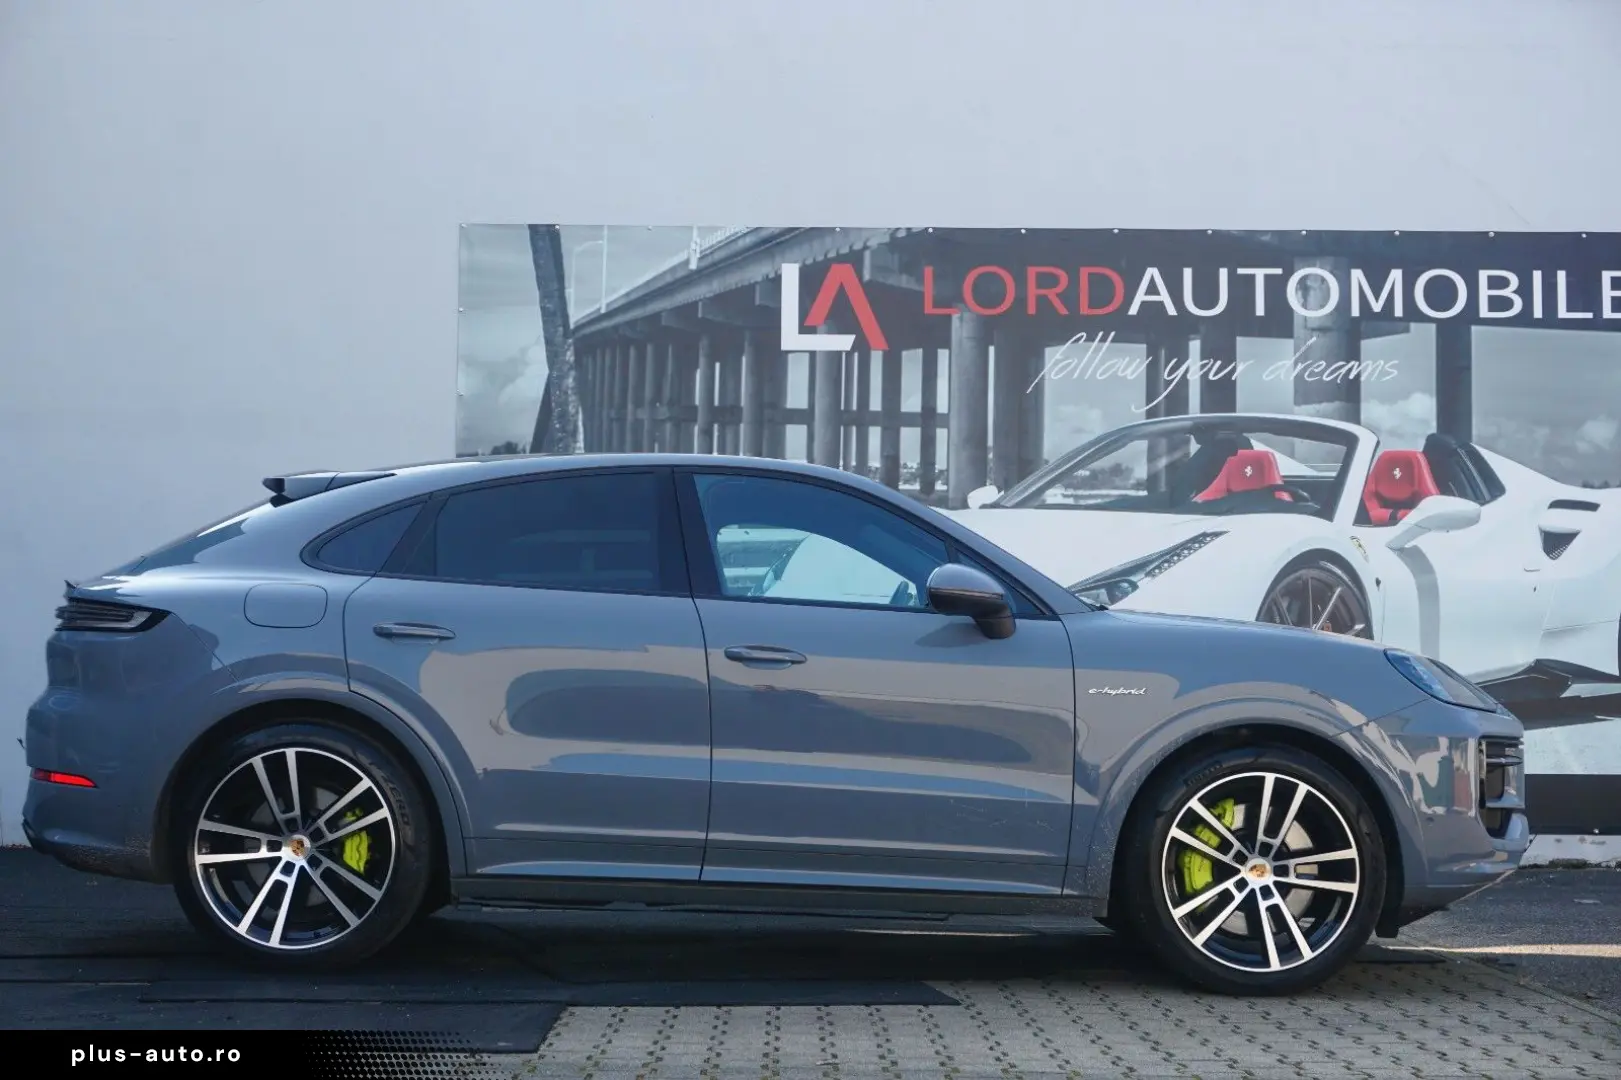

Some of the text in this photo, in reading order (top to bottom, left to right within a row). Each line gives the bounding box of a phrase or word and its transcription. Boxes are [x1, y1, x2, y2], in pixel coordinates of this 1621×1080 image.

[1026, 331, 1399, 413] follow your dreams
[1088, 686, 1147, 696] e-hybrid
